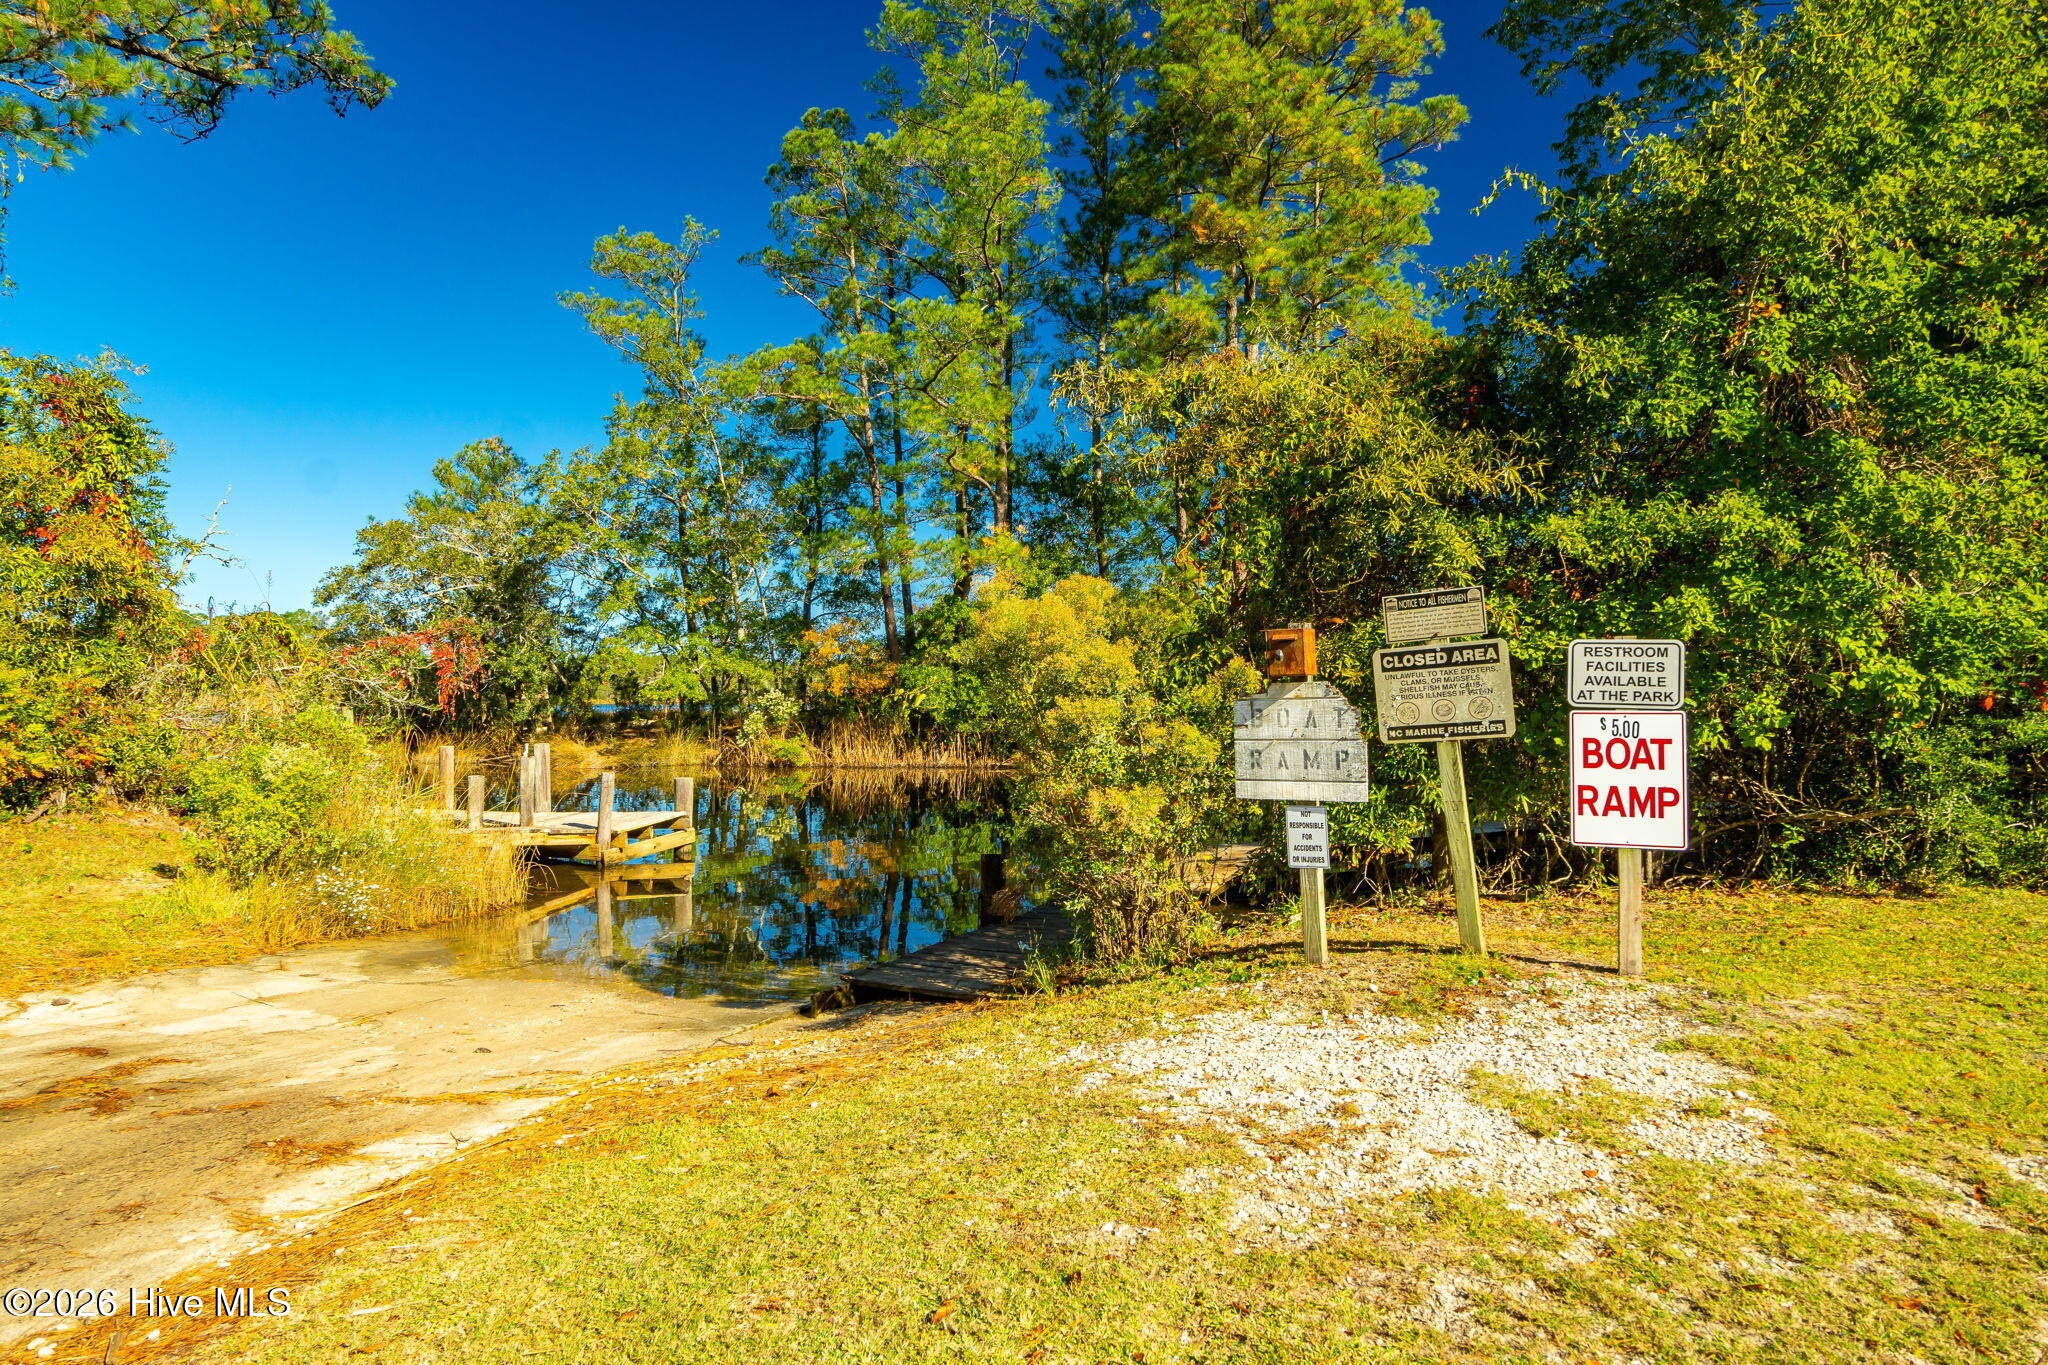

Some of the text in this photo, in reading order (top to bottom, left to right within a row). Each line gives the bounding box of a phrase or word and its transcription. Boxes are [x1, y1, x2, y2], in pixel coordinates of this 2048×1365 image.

[1399, 593, 1466, 608] NOTICE TO ALL FISHERMEN
[1382, 647, 1498, 668] CLOSED AREA
[1584, 646, 1669, 658] RESTROOM
[1586, 661, 1666, 672] FACILITIES
[1385, 672, 1426, 680] UNLAWFUL
[1584, 676, 1666, 687] AVAILABLE
[1400, 685, 1440, 694] SHELLFISH
[1426, 690, 1458, 698] ILLNESS
[1576, 690, 1674, 702] AT THE PARK
[1250, 707, 1350, 728] BOAT
[1406, 727, 1445, 736] MARINE
[1448, 724, 1504, 734] FISHERIES
[1250, 749, 1350, 770] RAMP
[1582, 738, 1672, 770] BOAT
[1578, 784, 1680, 818] RAMP
